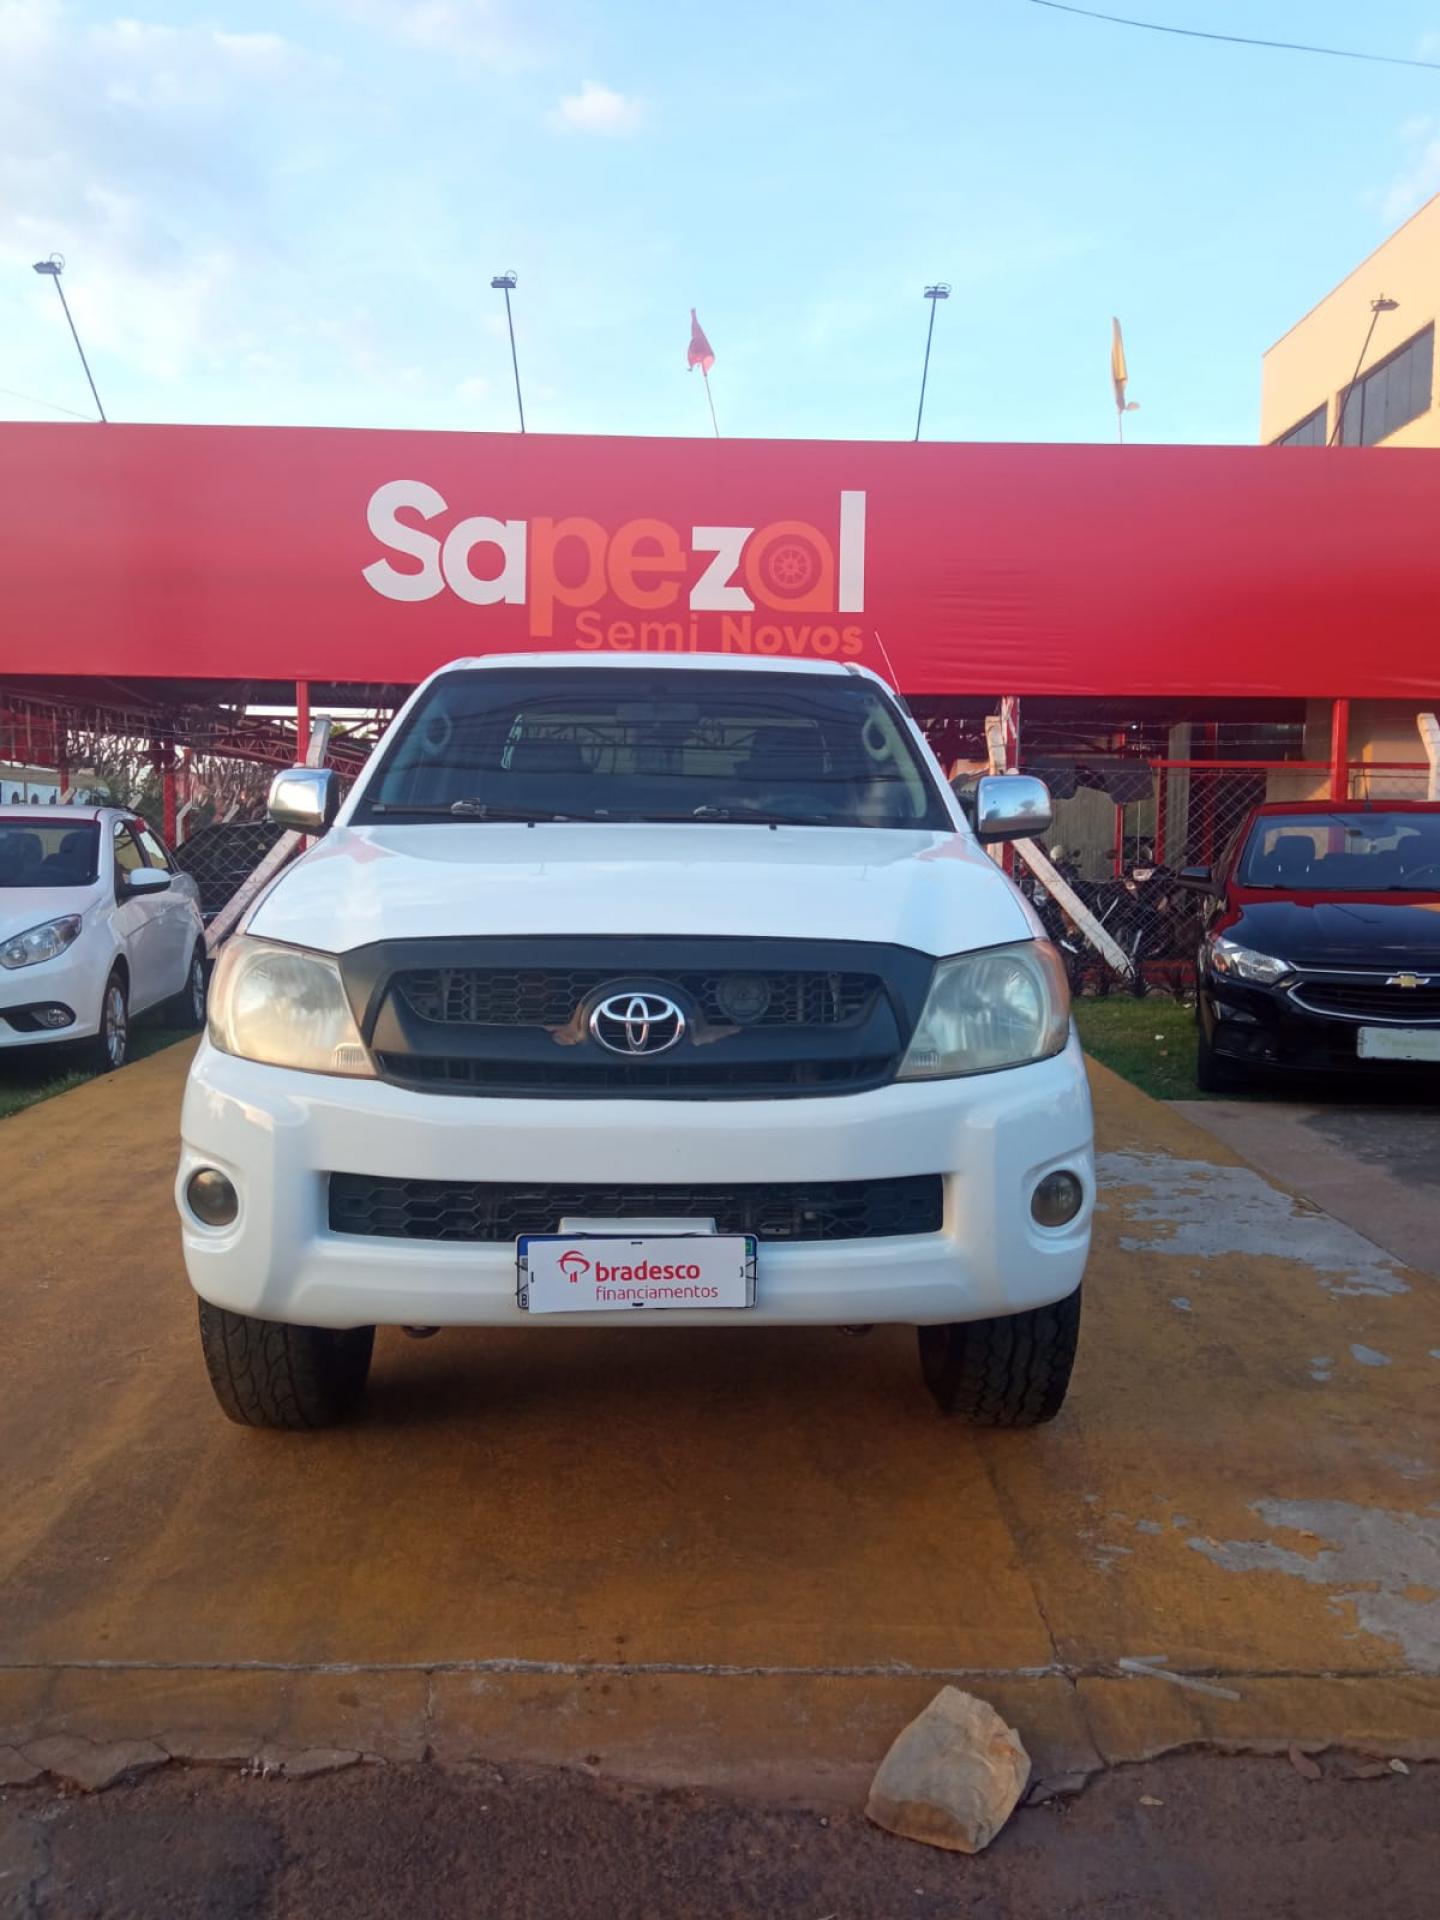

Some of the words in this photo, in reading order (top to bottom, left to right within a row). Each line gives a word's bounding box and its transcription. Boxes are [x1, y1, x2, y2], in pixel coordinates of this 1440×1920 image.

[362, 479, 866, 637] Sapezal
[575, 611, 698, 653] Semi
[721, 615, 863, 655] Novos
[595, 1260, 700, 1282] bradesco
[595, 1285, 719, 1301] financiamentos
